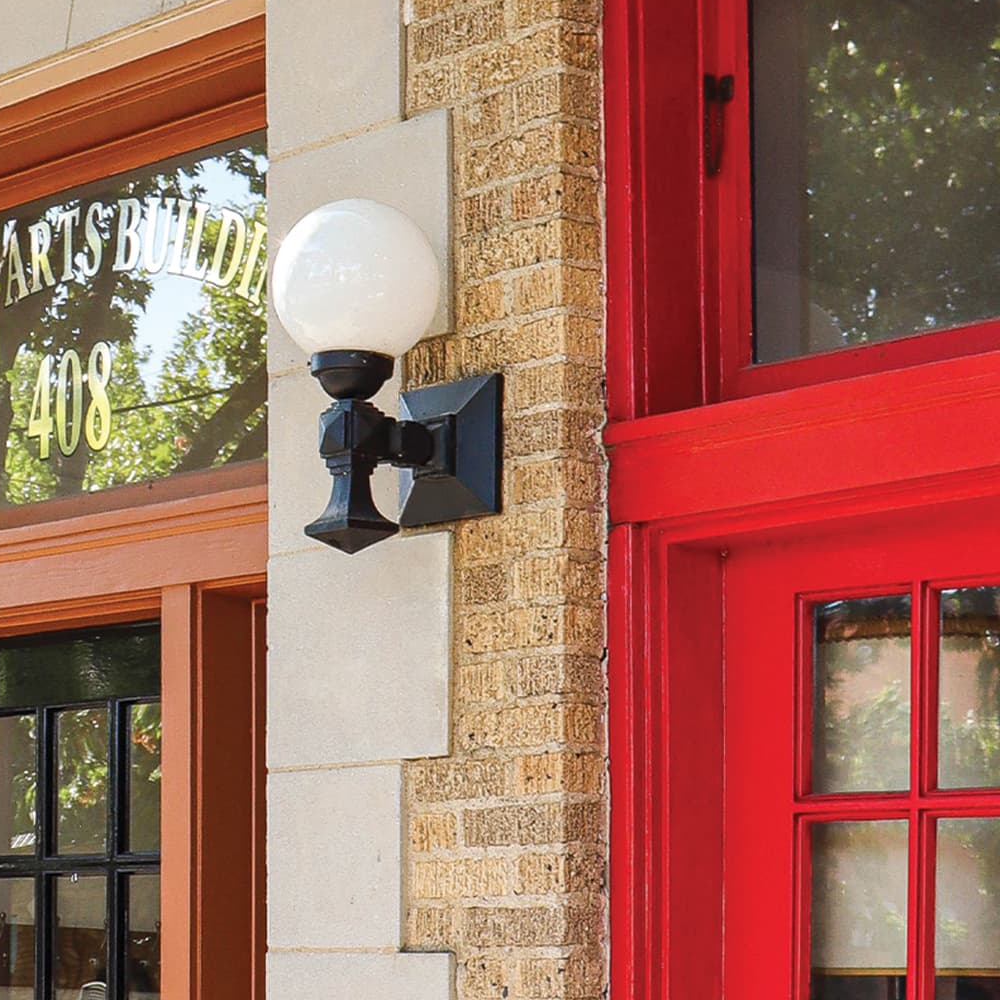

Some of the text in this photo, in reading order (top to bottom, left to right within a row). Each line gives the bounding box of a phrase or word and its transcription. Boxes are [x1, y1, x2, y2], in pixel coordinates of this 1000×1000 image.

[4, 201, 103, 308] ARTS
[111, 197, 268, 306] BUILDI
[27, 341, 112, 460] 408
